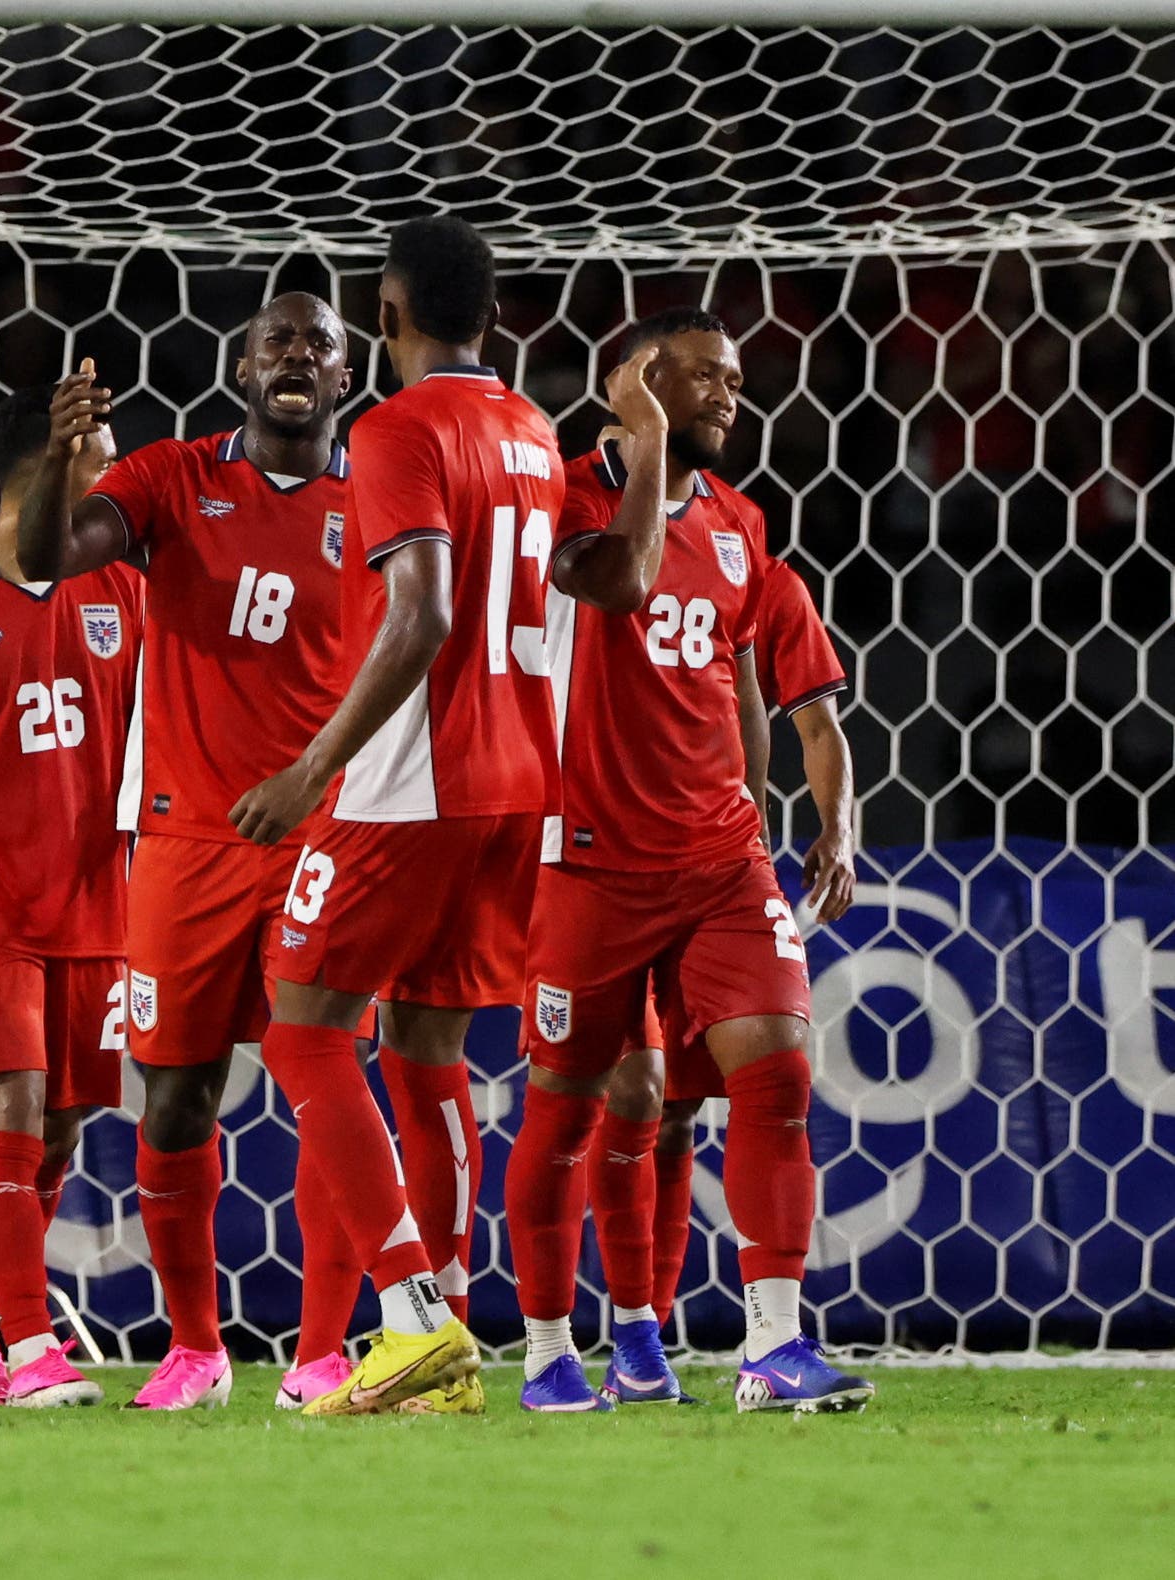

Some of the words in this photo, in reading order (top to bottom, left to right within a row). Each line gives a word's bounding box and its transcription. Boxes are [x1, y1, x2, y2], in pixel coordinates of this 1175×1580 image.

[499, 440, 551, 480] RAMOS
[198, 496, 235, 509] Reebok
[229, 566, 295, 644] 18
[647, 594, 716, 669] 28
[16, 677, 85, 754] 26
[284, 844, 335, 925] 13
[764, 898, 807, 965] 2
[99, 980, 125, 1050] 2
